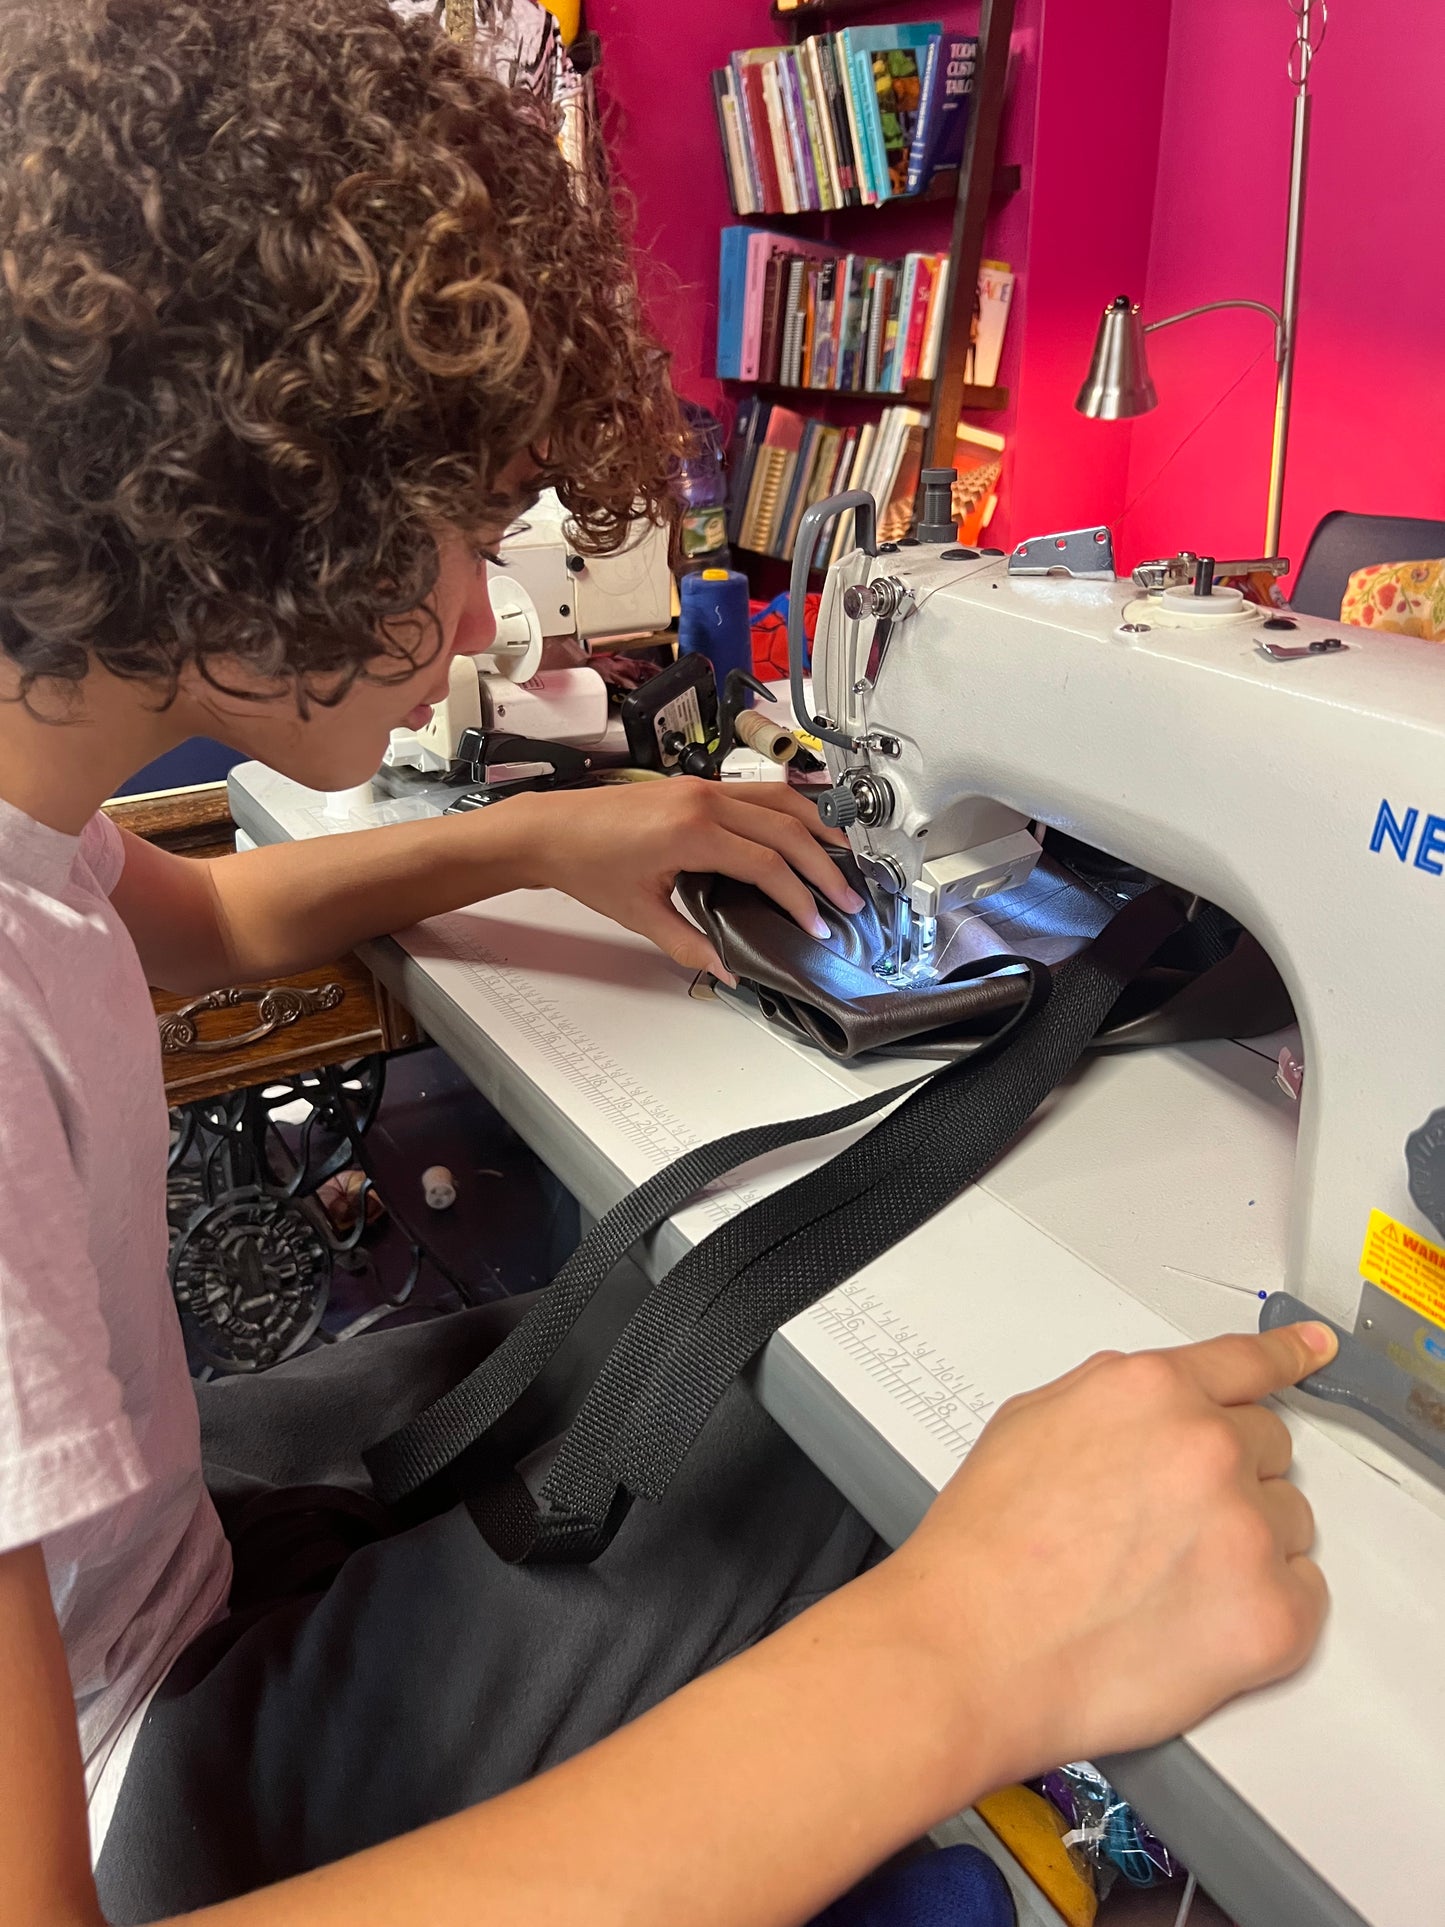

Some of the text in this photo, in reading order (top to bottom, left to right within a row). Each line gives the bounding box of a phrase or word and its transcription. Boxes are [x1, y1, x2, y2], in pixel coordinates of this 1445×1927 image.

[1369, 798, 1445, 877] NE
[833, 1306, 866, 1332] 26
[876, 1347, 911, 1372] 27
[923, 1391, 958, 1418] 28
